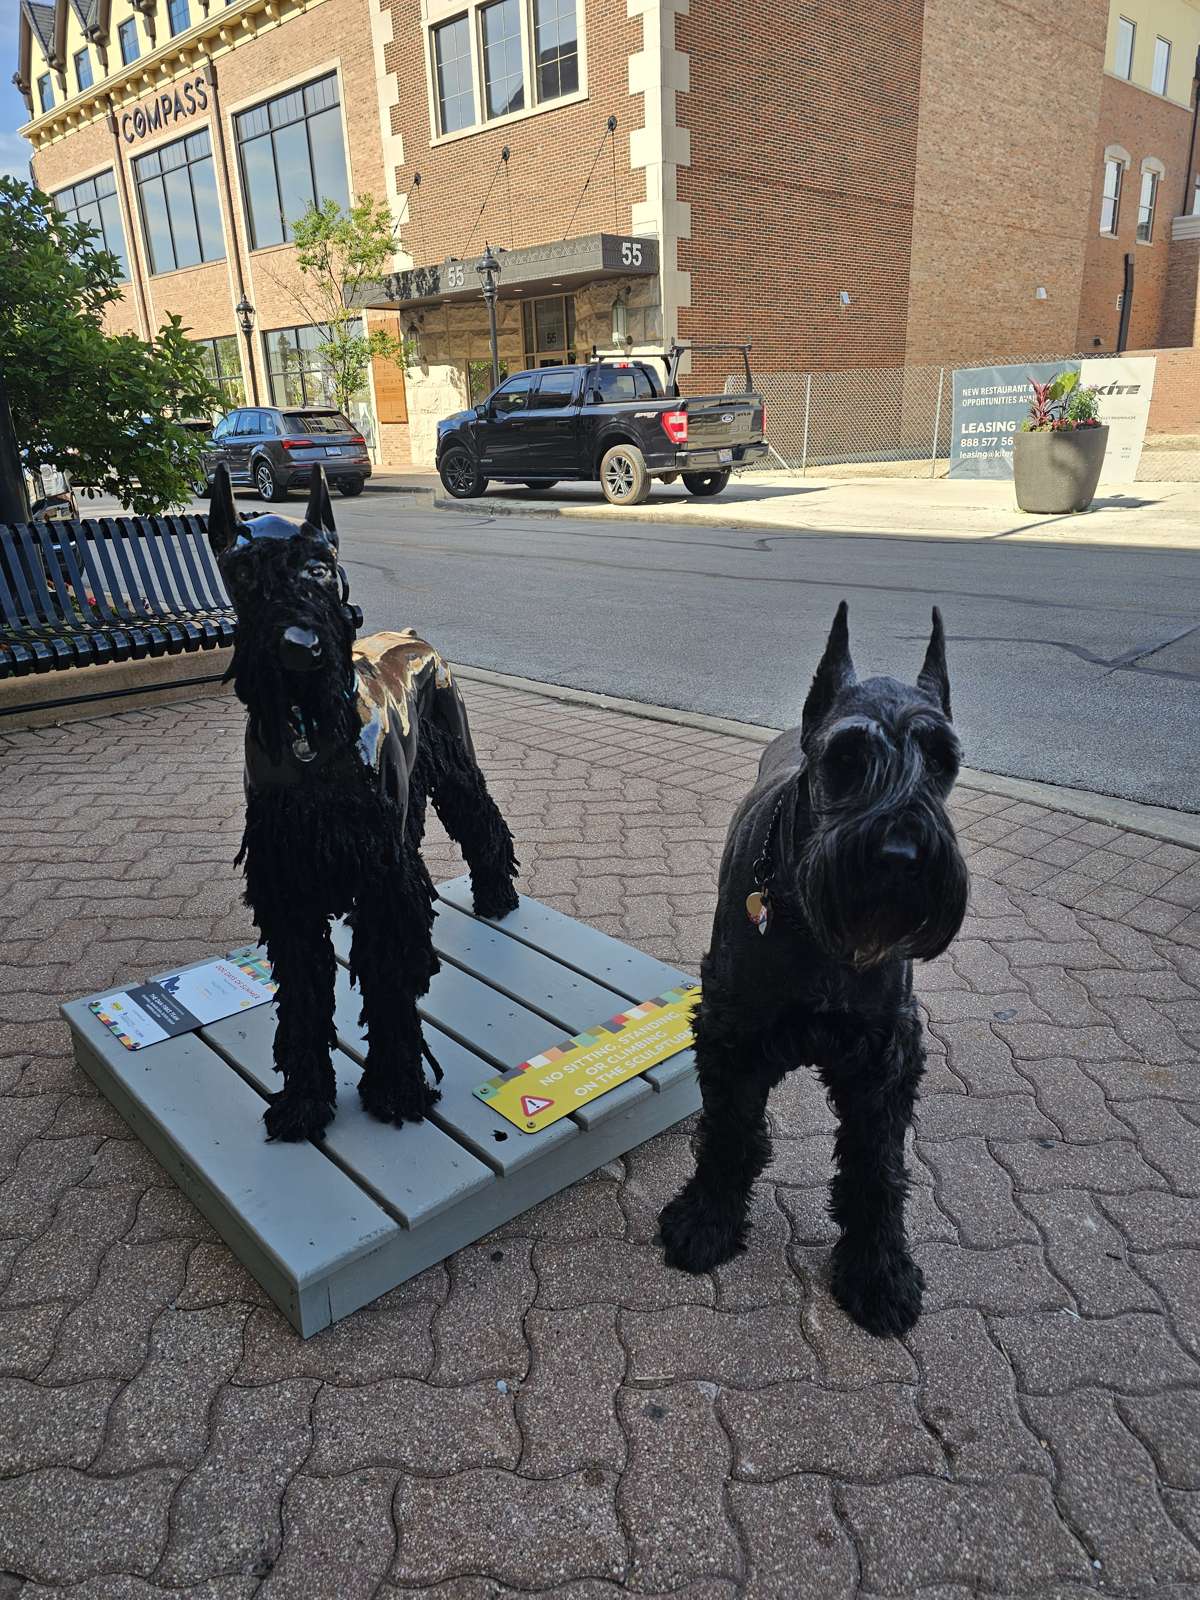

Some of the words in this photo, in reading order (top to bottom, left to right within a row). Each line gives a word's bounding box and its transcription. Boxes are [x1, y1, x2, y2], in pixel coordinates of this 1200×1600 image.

[122, 76, 208, 144] COMPASS
[622, 242, 642, 266] 55
[448, 265, 464, 288] 55
[962, 387, 980, 397] NEW
[981, 383, 1027, 396] RESTAURANT
[962, 396, 1017, 408] OPPORTUNITIES
[961, 420, 1017, 434] LEASING
[960, 438, 979, 448] 888
[981, 437, 998, 447] 577
[585, 1062, 609, 1075] OR
[607, 1031, 666, 1064] CLIMBING
[539, 1071, 564, 1086] NO
[575, 1081, 598, 1096] ON
[596, 1065, 626, 1084] THE
